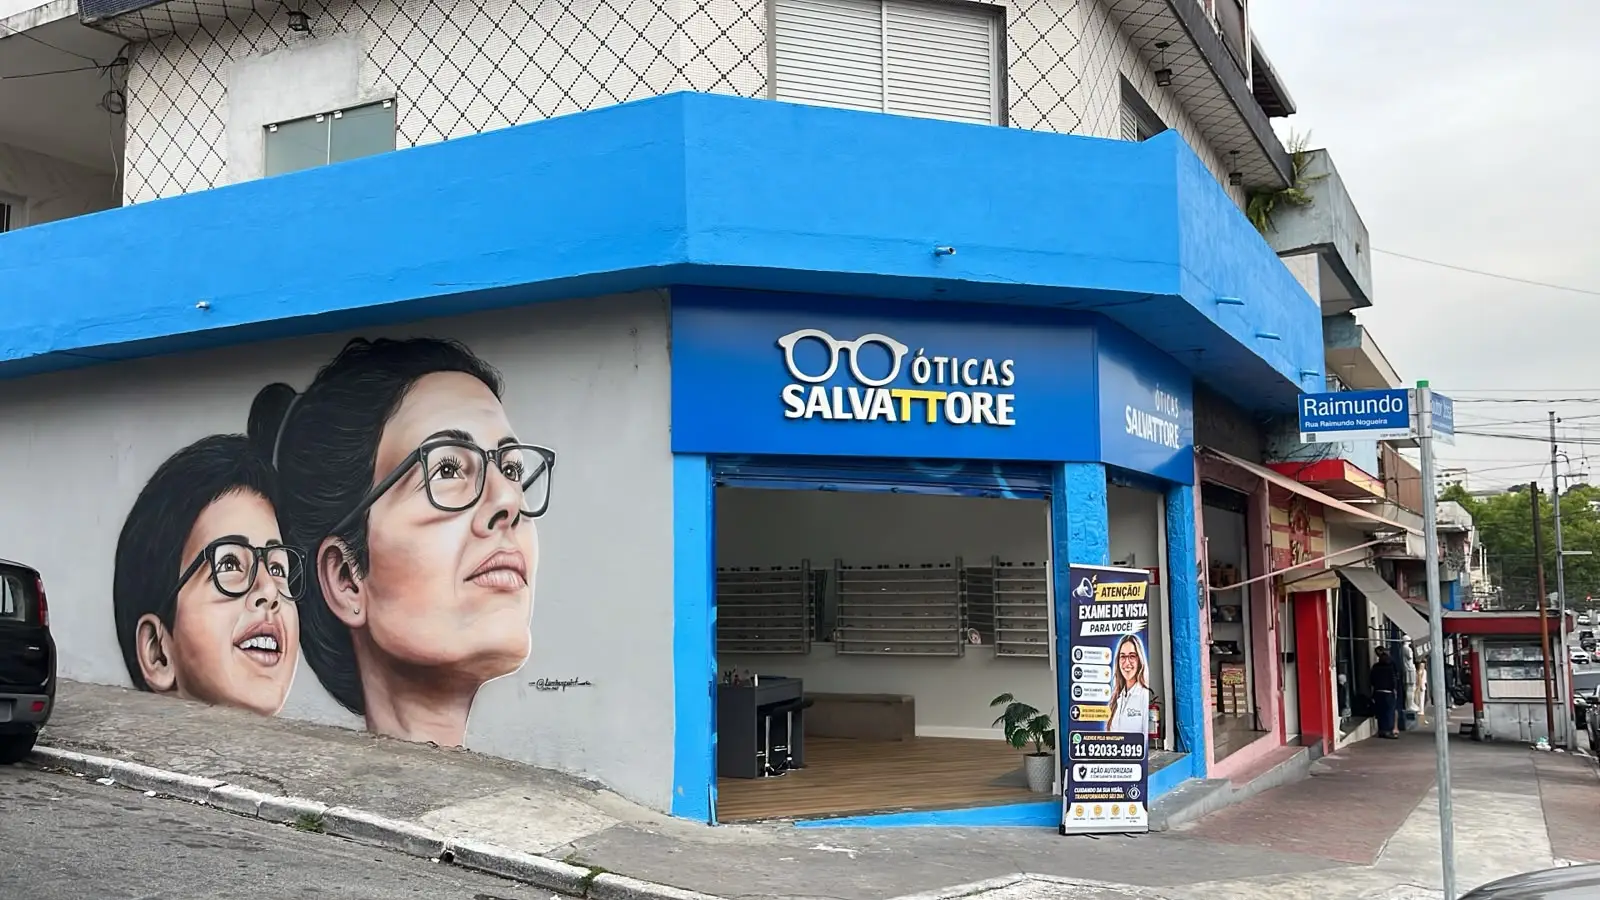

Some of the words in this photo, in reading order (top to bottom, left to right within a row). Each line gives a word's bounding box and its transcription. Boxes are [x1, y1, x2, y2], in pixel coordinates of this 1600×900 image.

[911, 348, 1015, 387] ÓTICAS
[781, 384, 1016, 426] SALVATTORE
[1155, 383, 1179, 419] ÓTICAS
[1303, 395, 1403, 417] Raimundo
[1125, 405, 1180, 450] SALVATTORE
[1320, 419, 1355, 428] Raimundo
[1356, 418, 1388, 427] Nogueira
[1100, 585, 1140, 599] ATENÇÃO!
[1079, 604, 1111, 619] EXAME
[1112, 604, 1124, 618] DE
[1124, 603, 1148, 617] VISTA
[1089, 623, 1110, 632] PARA
[1111, 621, 1133, 632] VOCÊ!
[1075, 744, 1087, 757] 11
[1088, 744, 1143, 757] 92033-1919
[1090, 766, 1104, 774] AÇÃO
